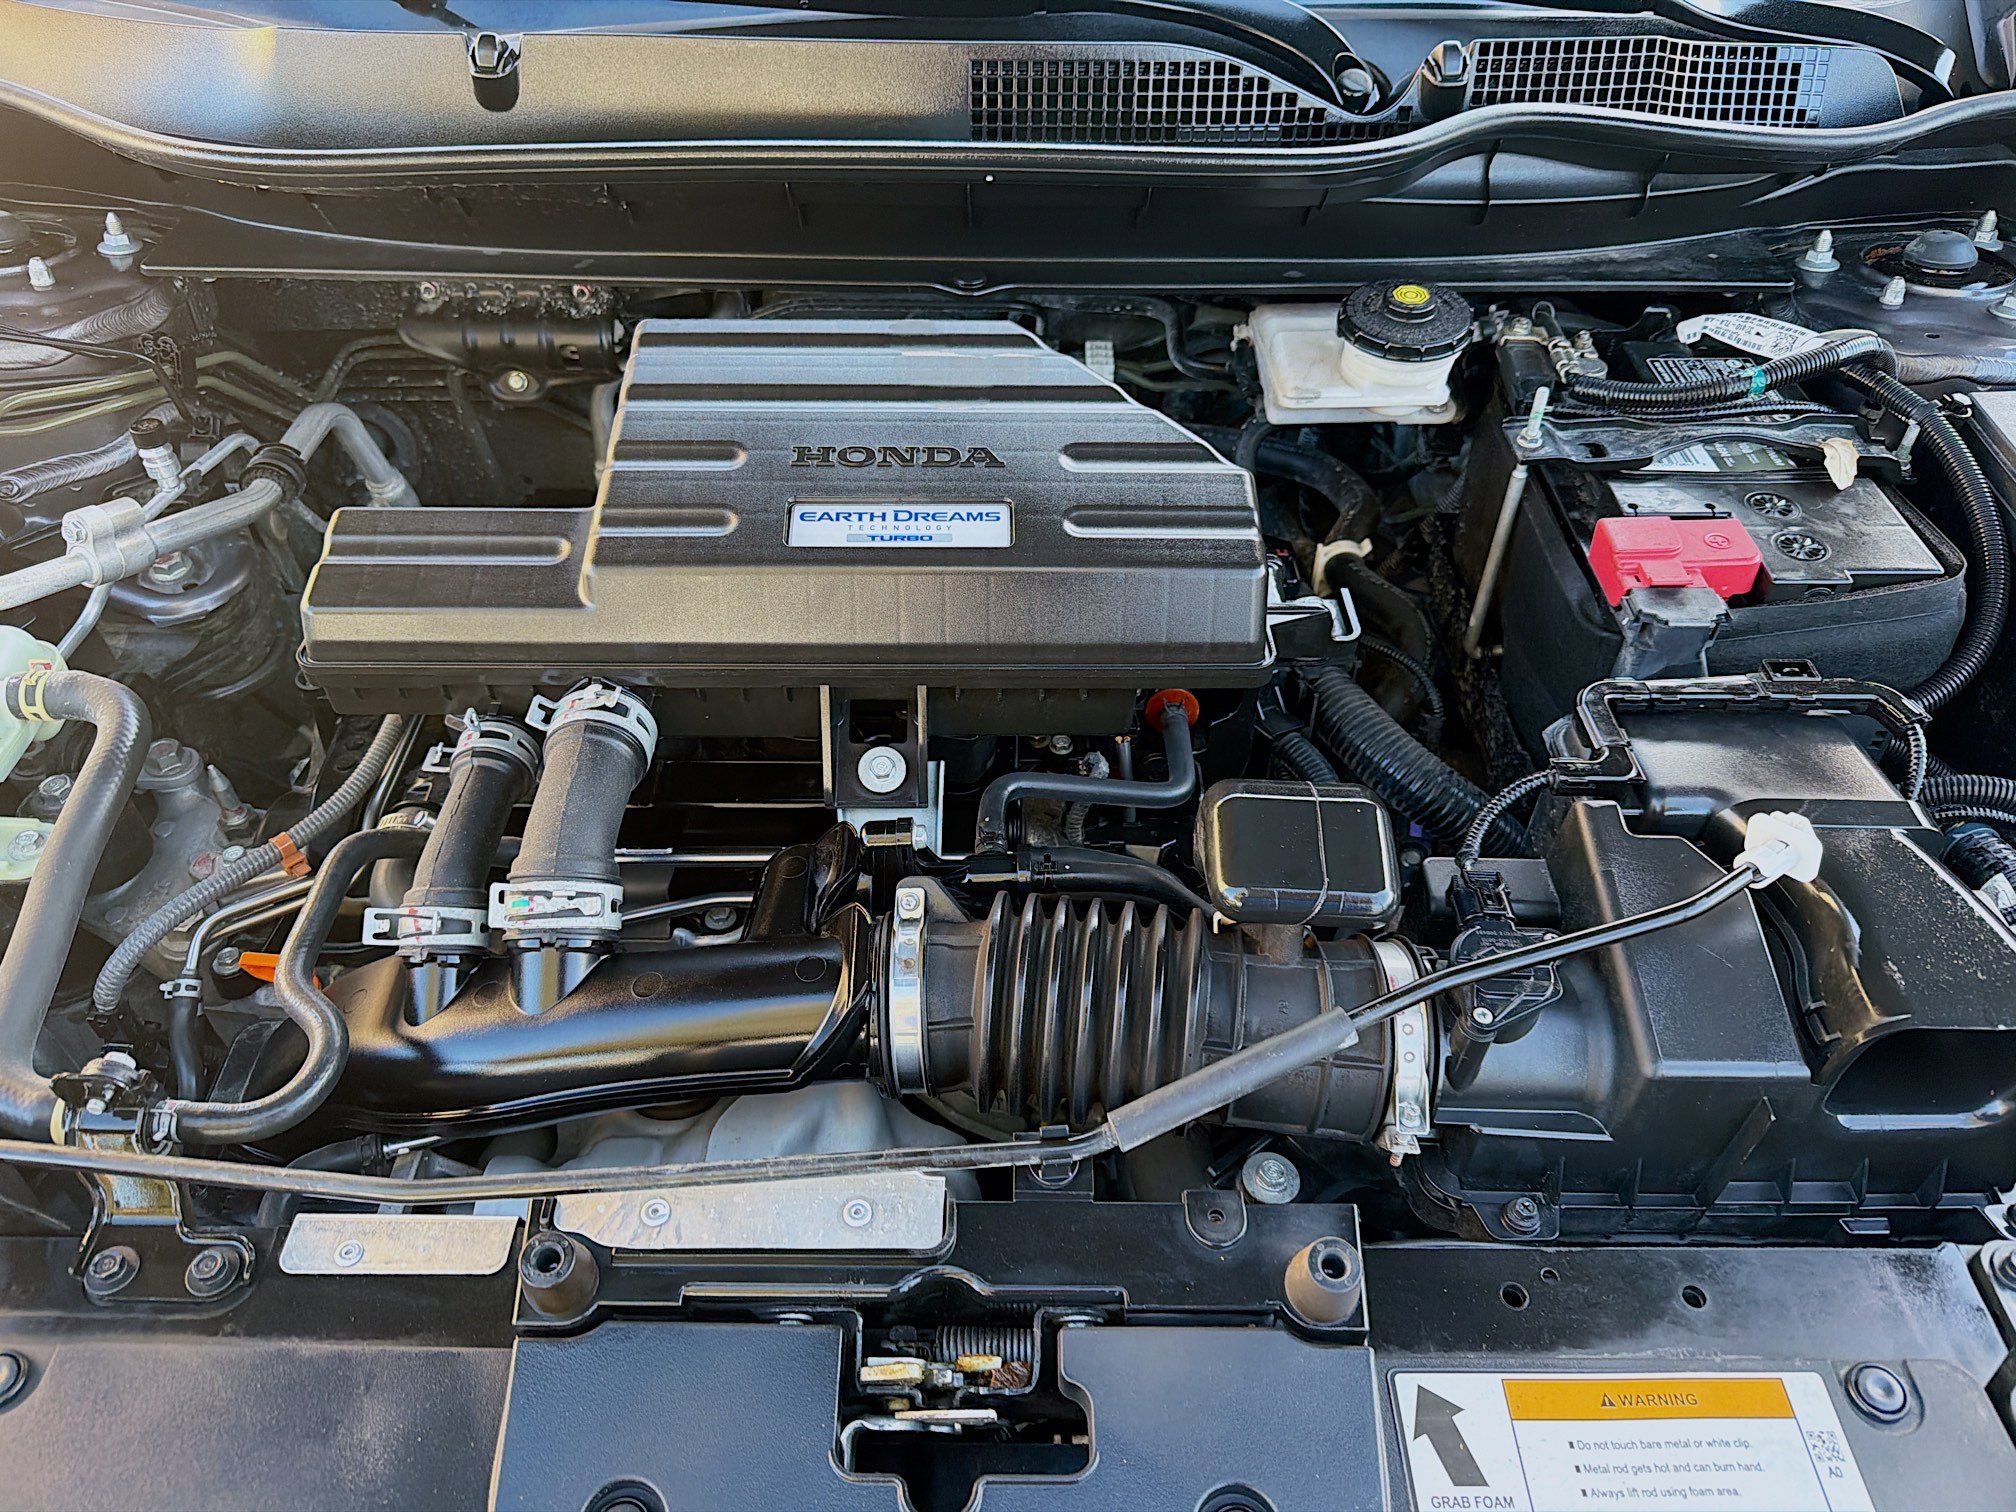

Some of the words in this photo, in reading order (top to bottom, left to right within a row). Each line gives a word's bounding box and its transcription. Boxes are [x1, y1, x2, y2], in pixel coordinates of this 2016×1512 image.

[790, 446, 1006, 468] HONDA
[799, 511, 888, 522] EARTH
[893, 509, 1001, 522] DREAMS
[867, 534, 932, 542] TURBO
[1618, 1393, 1698, 1407] WARNING
[1577, 1440, 1591, 1450] Do
[1594, 1440, 1609, 1450] not
[1611, 1439, 1638, 1450] touch
[1640, 1439, 1662, 1450] bare
[1664, 1439, 1691, 1449] metal
[1694, 1440, 1703, 1448] or
[1706, 1438, 1731, 1448] white
[1733, 1438, 1753, 1450] clip.
[1583, 1464, 1610, 1474] Metal
[1613, 1464, 1629, 1474] rod
[1631, 1464, 1652, 1476] gets
[1653, 1463, 1670, 1473] hot
[1673, 1463, 1691, 1472] and
[1694, 1464, 1711, 1472] can
[1713, 1462, 1735, 1472] burn
[1737, 1462, 1765, 1472] hand.
[1591, 1488, 1625, 1501] Always
[1626, 1488, 1639, 1498] lift
[1641, 1487, 1658, 1498] rod
[1660, 1487, 1688, 1500] using
[1689, 1486, 1714, 1496] foam
[1717, 1488, 1742, 1497] area.
[1431, 1496, 1471, 1509] GRAB
[1474, 1496, 1515, 1509] FOAM
